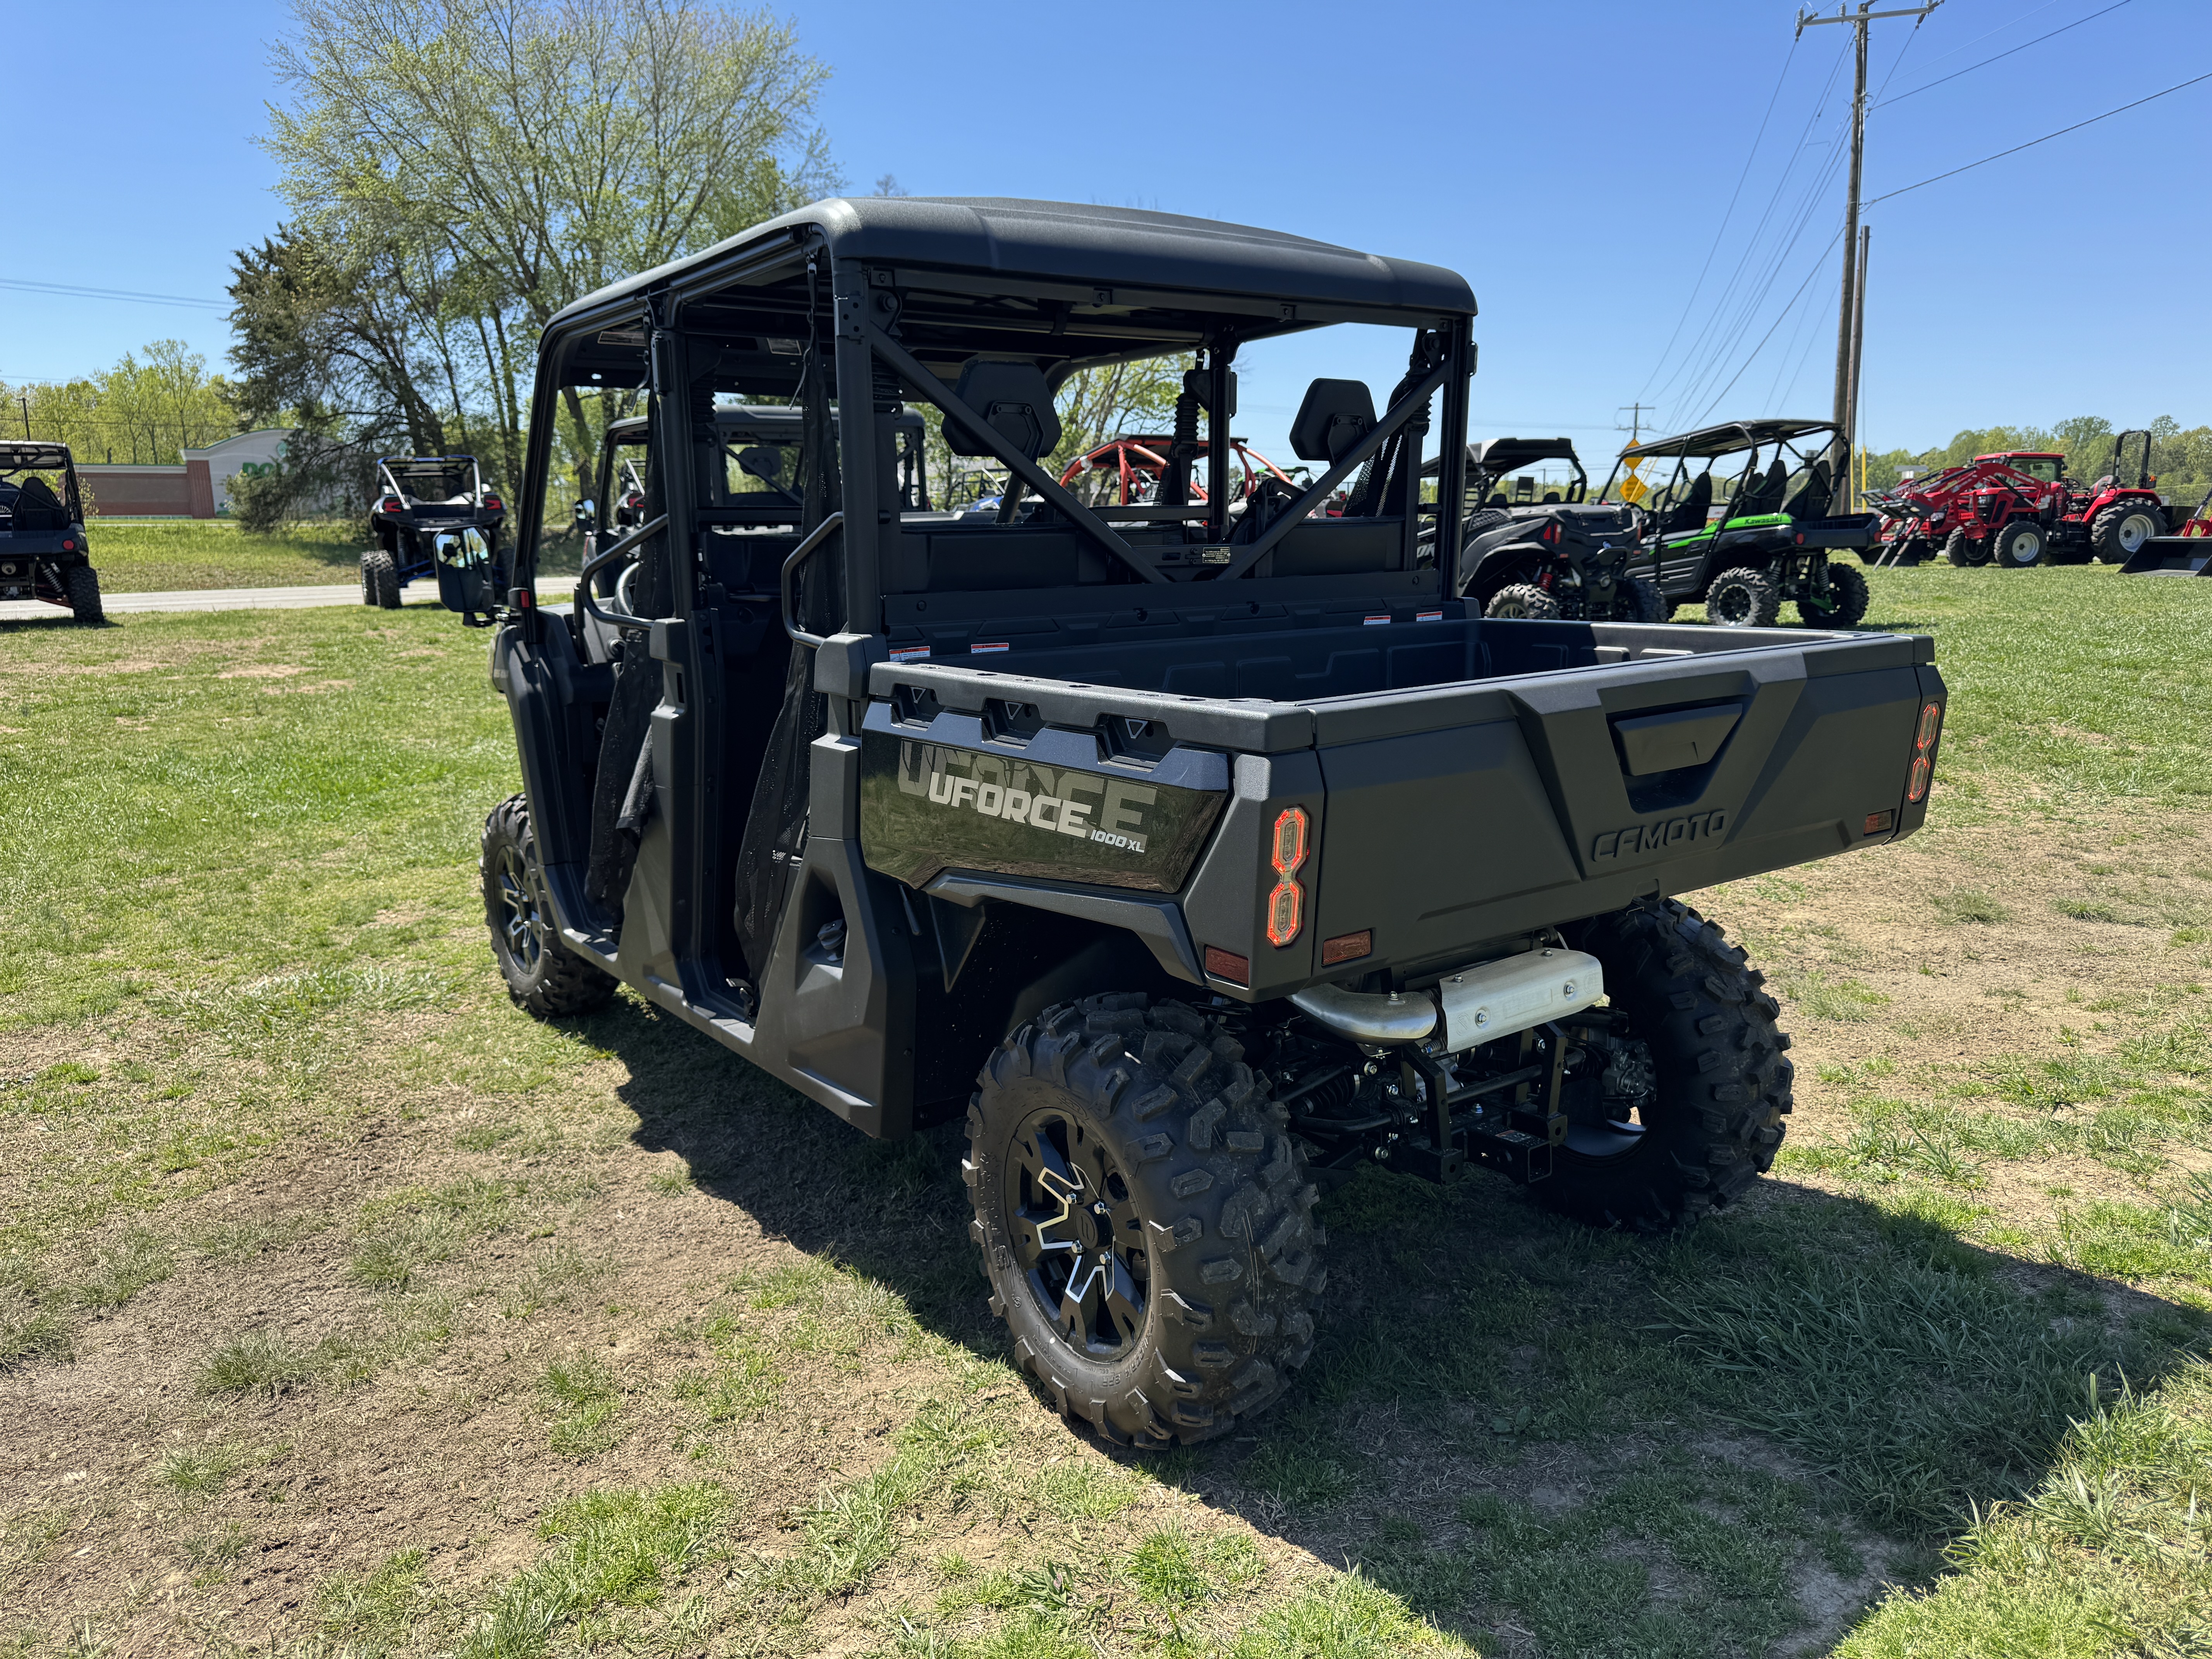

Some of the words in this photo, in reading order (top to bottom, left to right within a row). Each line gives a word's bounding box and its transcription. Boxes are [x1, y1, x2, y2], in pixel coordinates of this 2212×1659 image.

[1745, 516, 1783, 524] Kawasaki
[929, 772, 1092, 838] UFORCE
[1091, 830, 1127, 848] 1000
[1127, 840, 1144, 853] XL
[1593, 809, 1728, 862] CFMOTO
